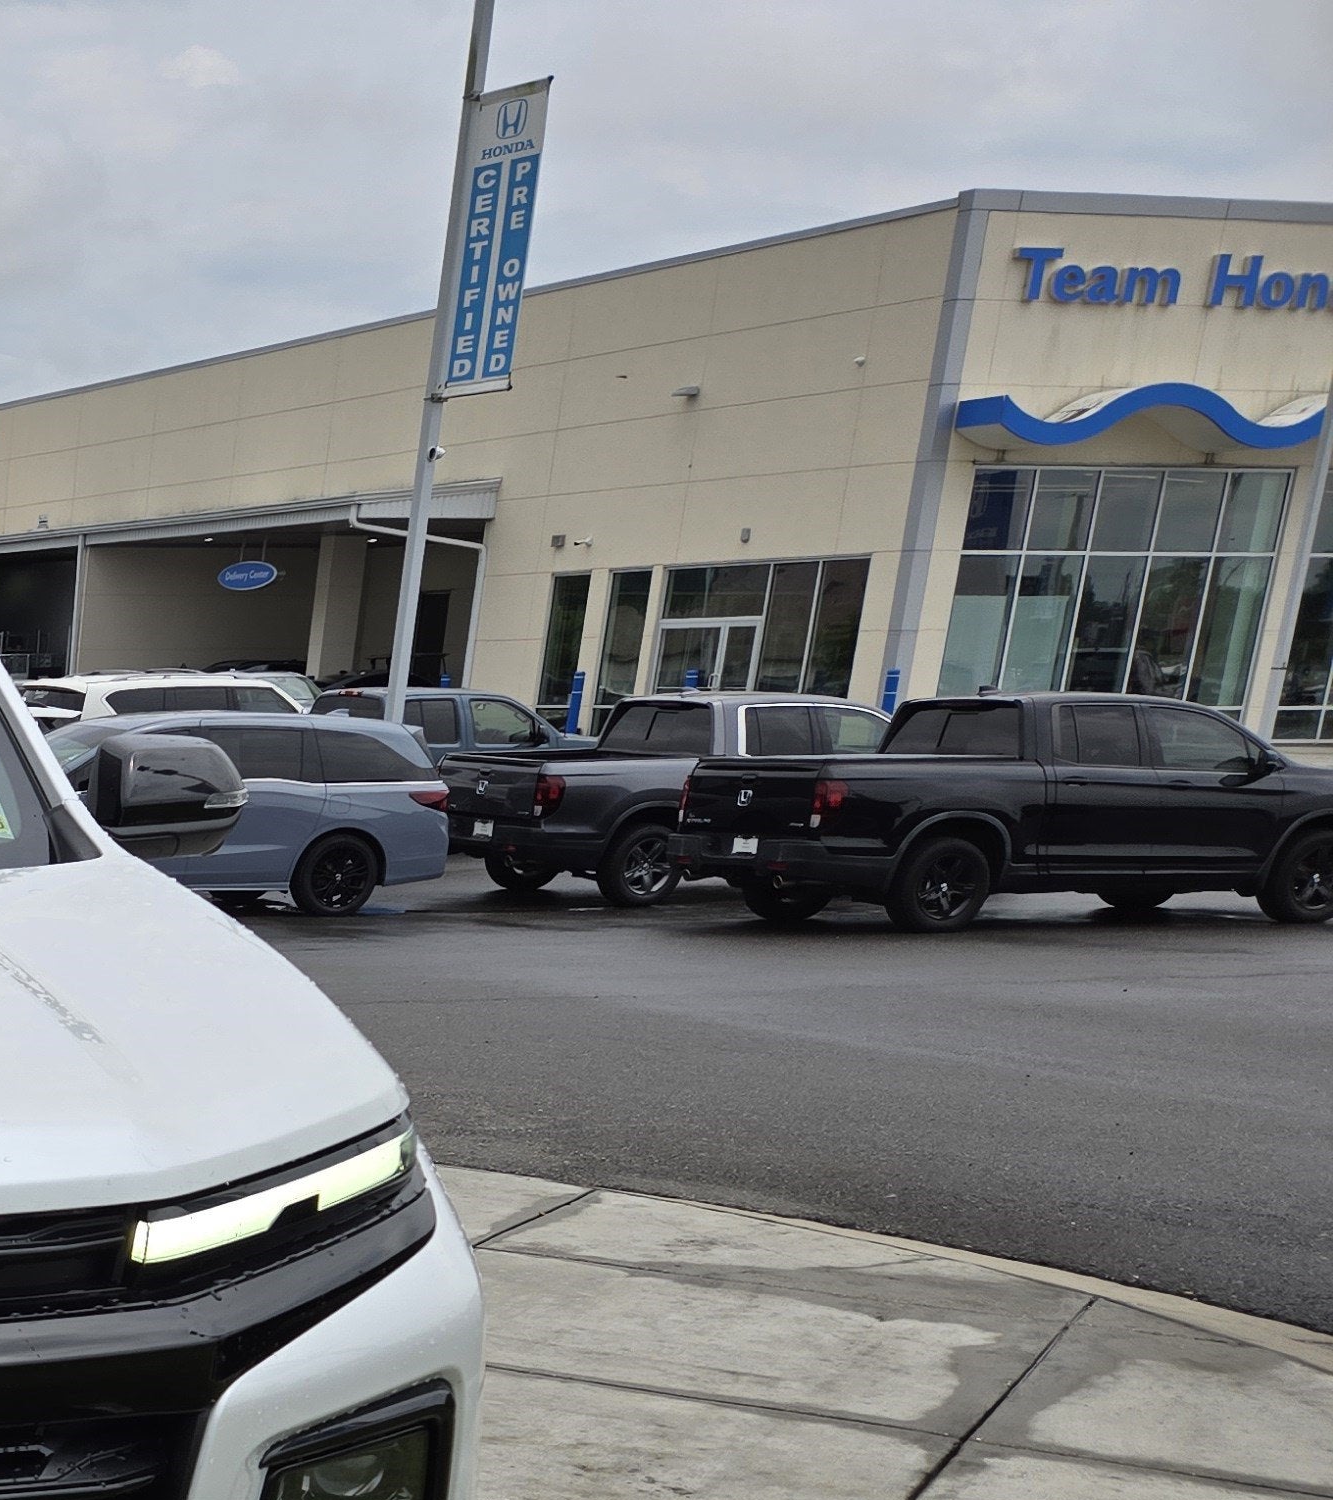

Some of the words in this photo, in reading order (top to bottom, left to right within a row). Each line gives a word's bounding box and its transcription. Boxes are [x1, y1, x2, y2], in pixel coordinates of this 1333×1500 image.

[481, 138, 535, 160] HONDA
[510, 161, 531, 230] PRE
[452, 168, 497, 379] CERTIFIED
[1014, 247, 1181, 305] Team
[1207, 253, 1331, 310] Hon
[488, 257, 520, 373] OWNED
